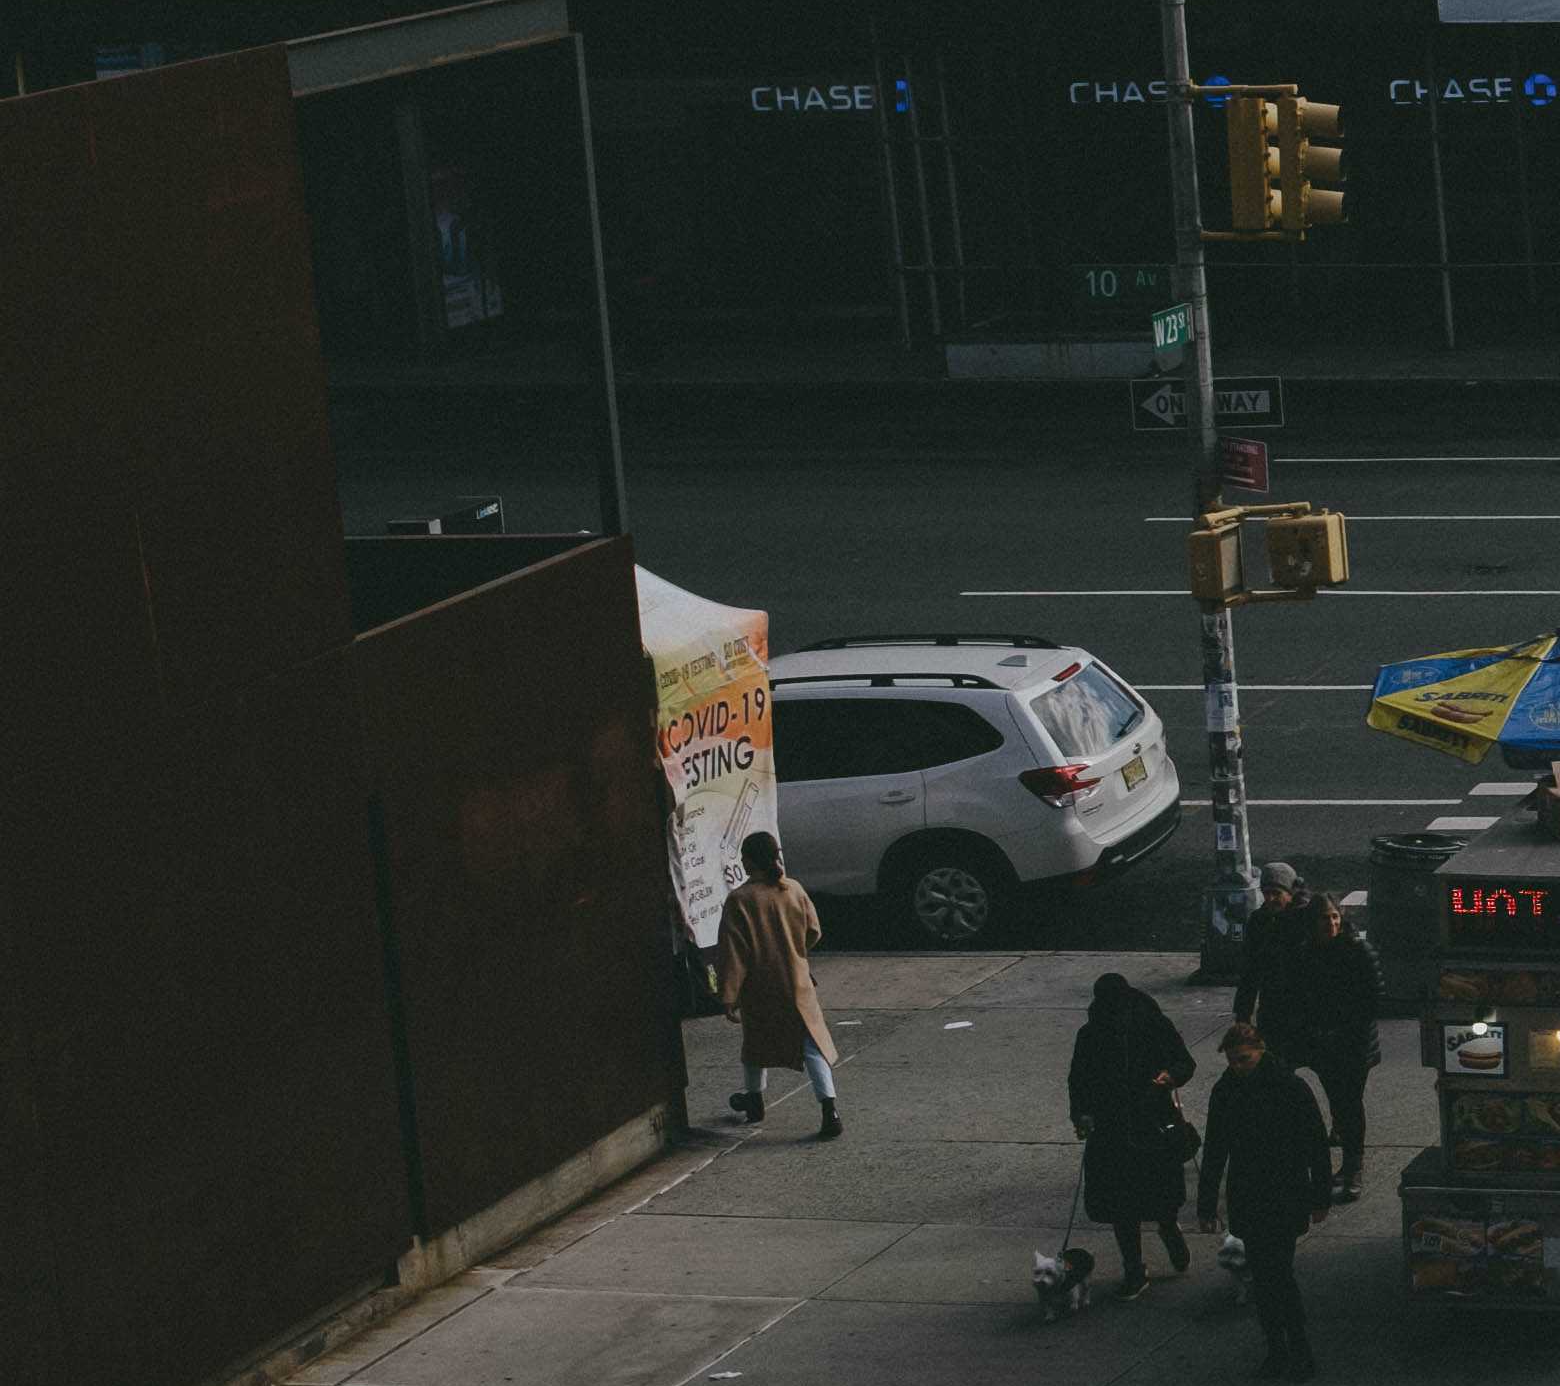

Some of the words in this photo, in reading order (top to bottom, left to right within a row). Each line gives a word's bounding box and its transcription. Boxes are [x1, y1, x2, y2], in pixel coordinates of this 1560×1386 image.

[750, 84, 875, 112] CHASE
[1068, 79, 1168, 104] CHAS
[1085, 270, 1118, 297] 10
[1152, 318, 1166, 348] W
[1166, 314, 1178, 344] 23
[1155, 395, 1183, 415] ON
[1216, 394, 1261, 413] WAY
[668, 687, 765, 753] COVID-19
[724, 864, 743, 885] $0
